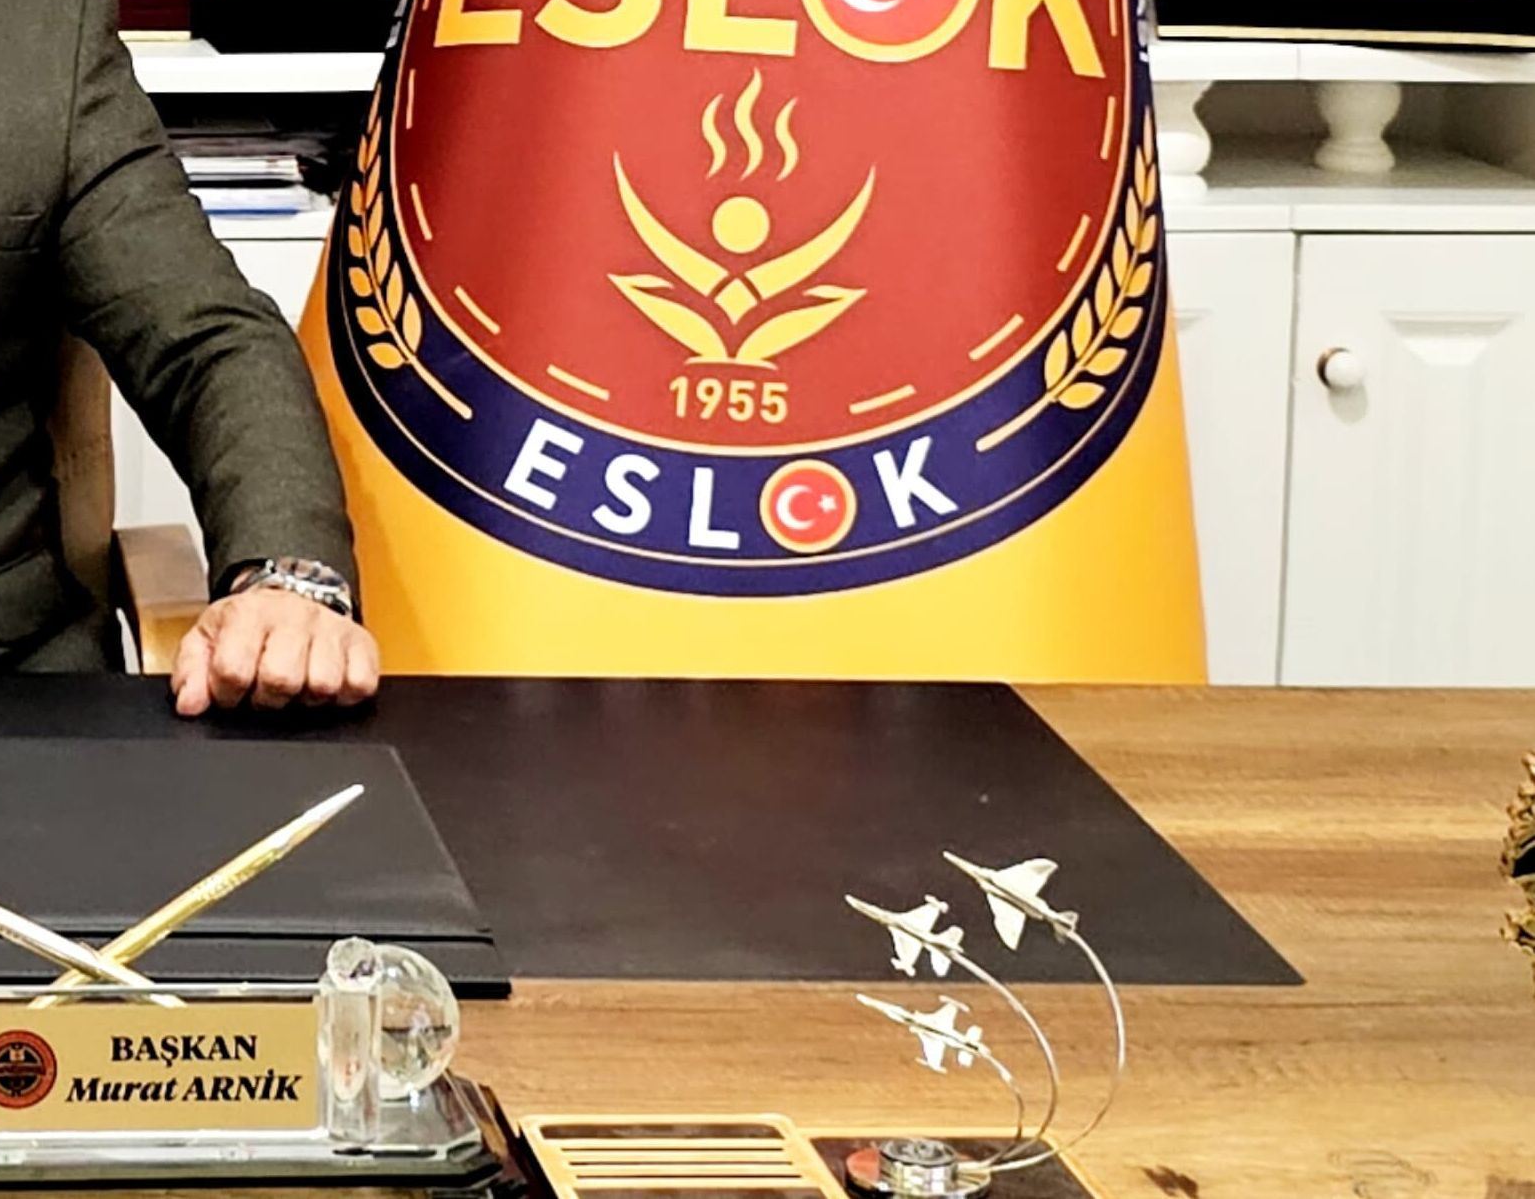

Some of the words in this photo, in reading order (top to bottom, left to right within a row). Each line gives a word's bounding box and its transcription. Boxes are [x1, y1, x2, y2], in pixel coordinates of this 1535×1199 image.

[668, 375, 789, 423] 1955
[503, 418, 960, 554] ESLOK
[110, 1035, 258, 1067] BAŞKAN
[66, 1076, 178, 1103] Murat
[181, 1068, 302, 1102] ARNİK
